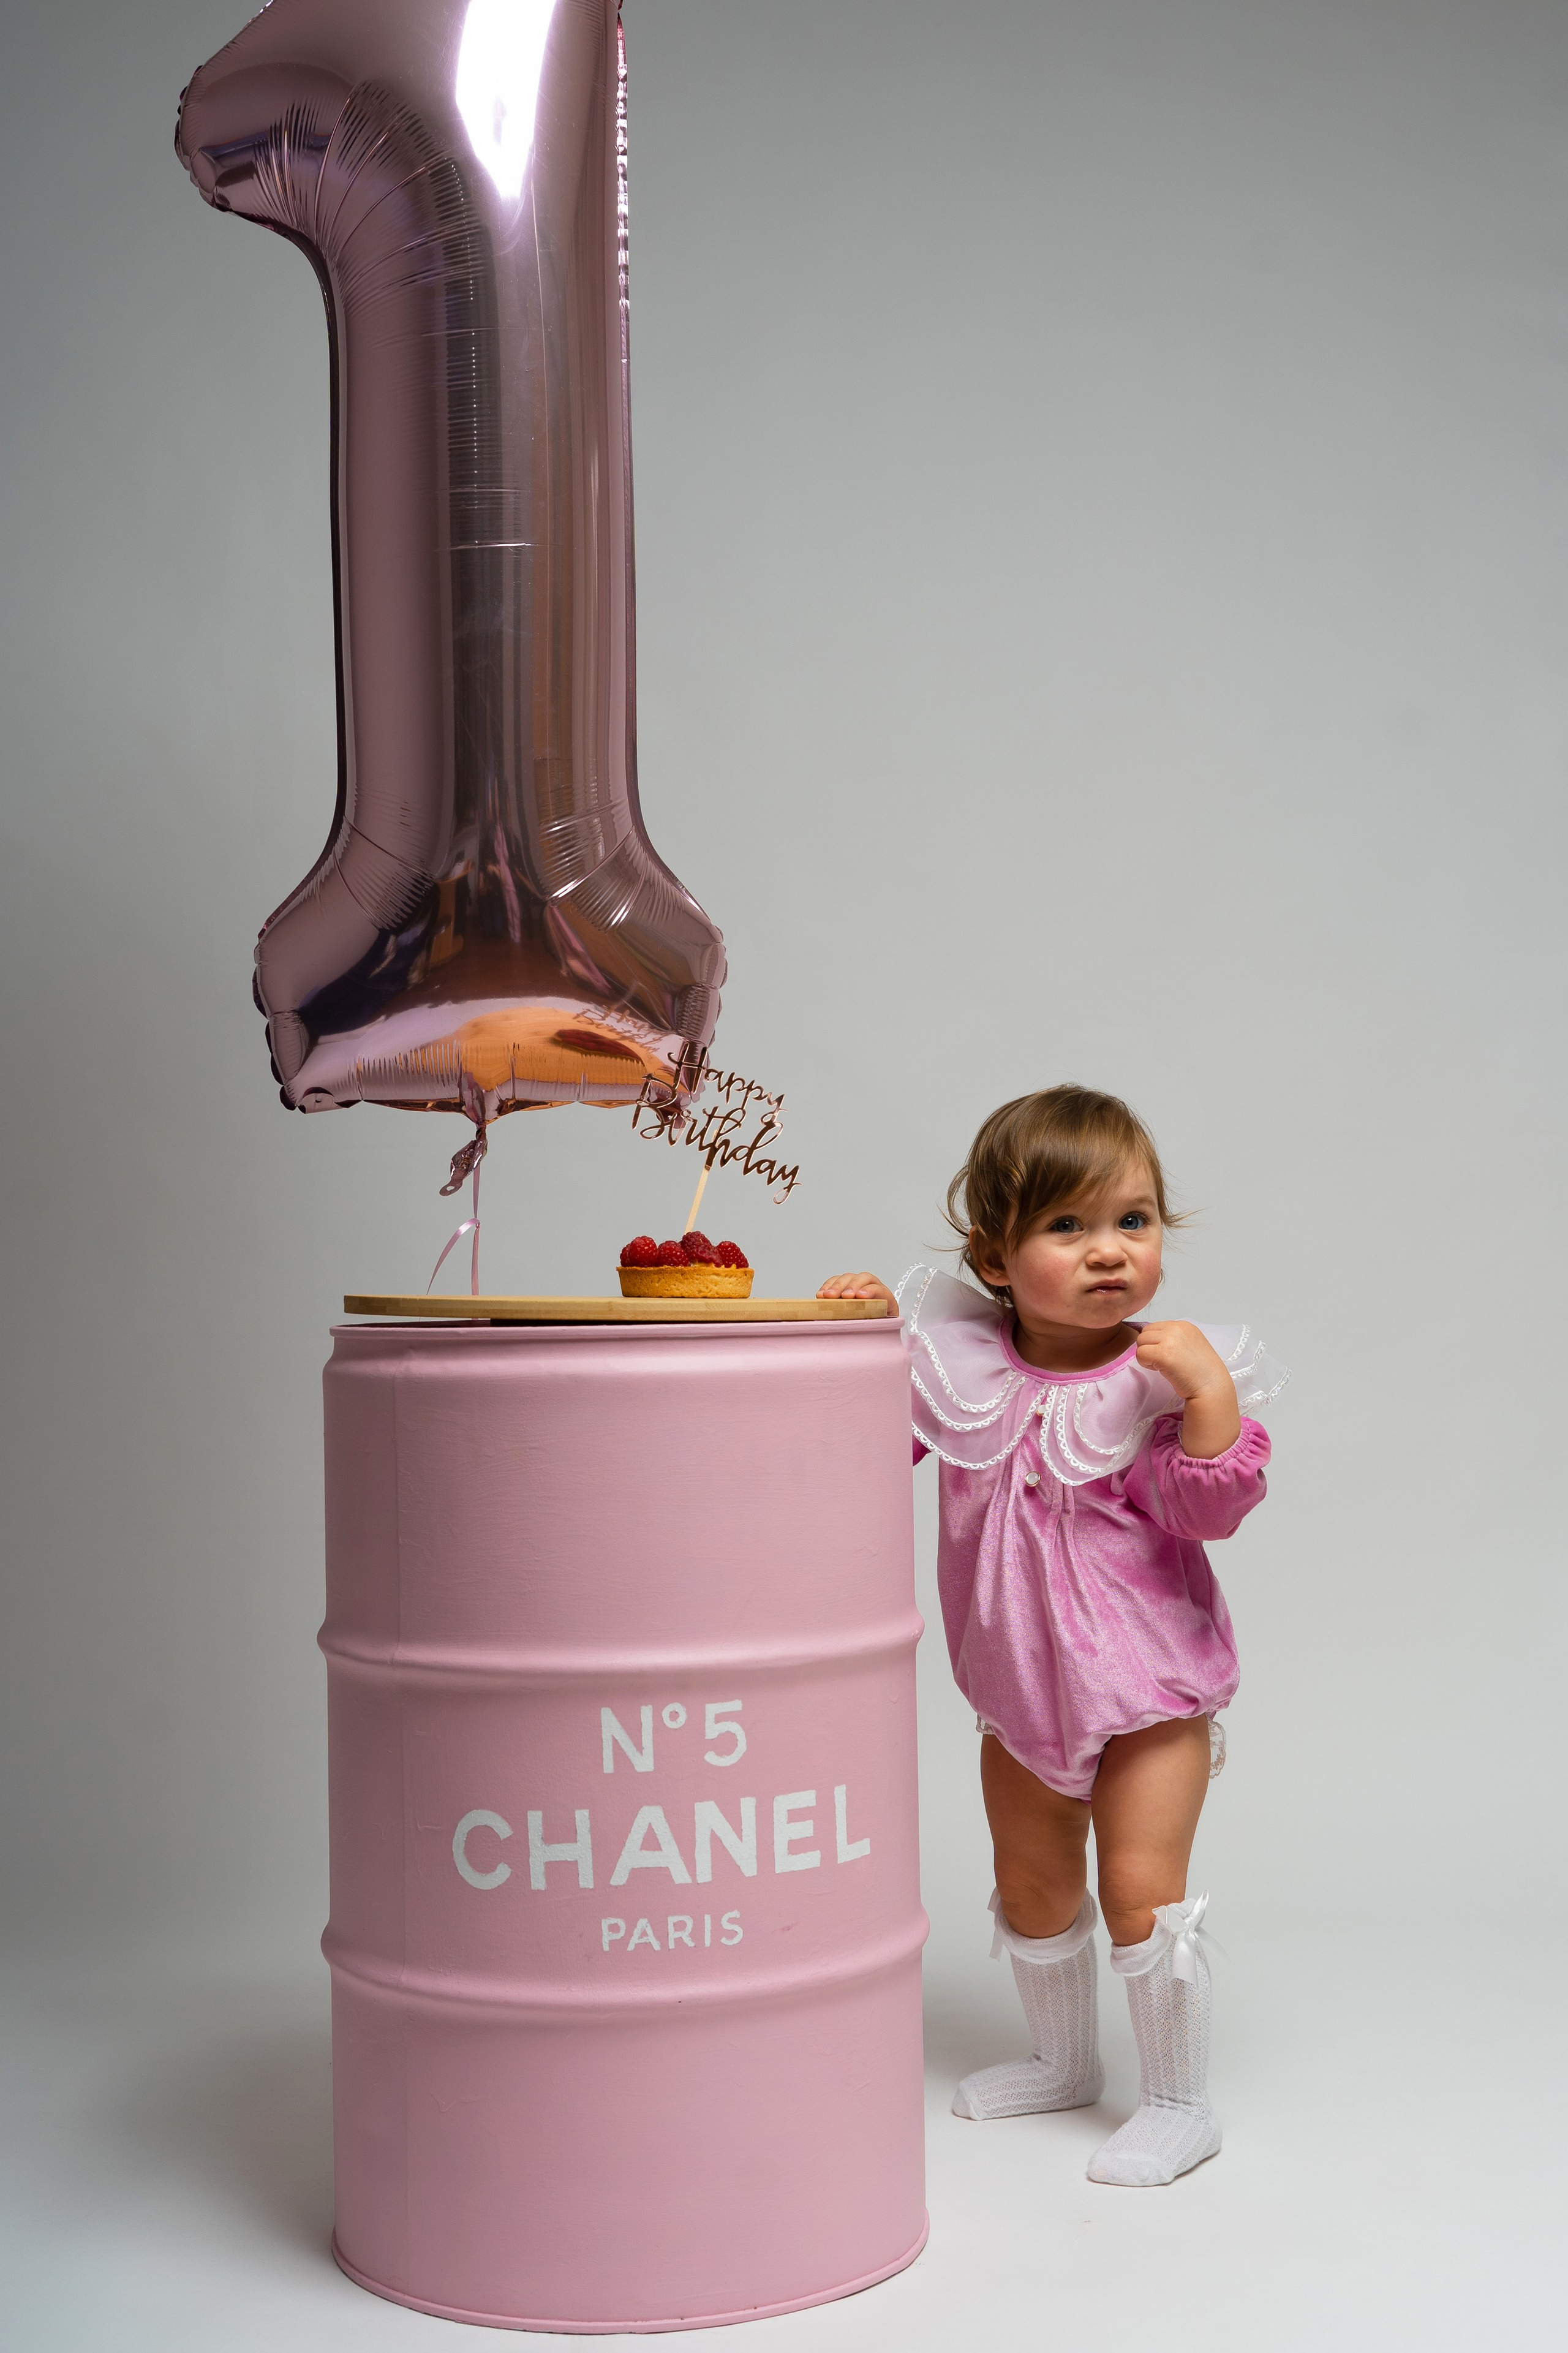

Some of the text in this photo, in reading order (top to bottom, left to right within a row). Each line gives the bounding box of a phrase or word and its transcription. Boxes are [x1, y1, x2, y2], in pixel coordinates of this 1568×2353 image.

[666, 1041, 790, 1124] Happy
[631, 1073, 804, 1205] Birthday
[452, 1784, 870, 1890] CHANEL
[601, 1910, 744, 1952] PARIS
